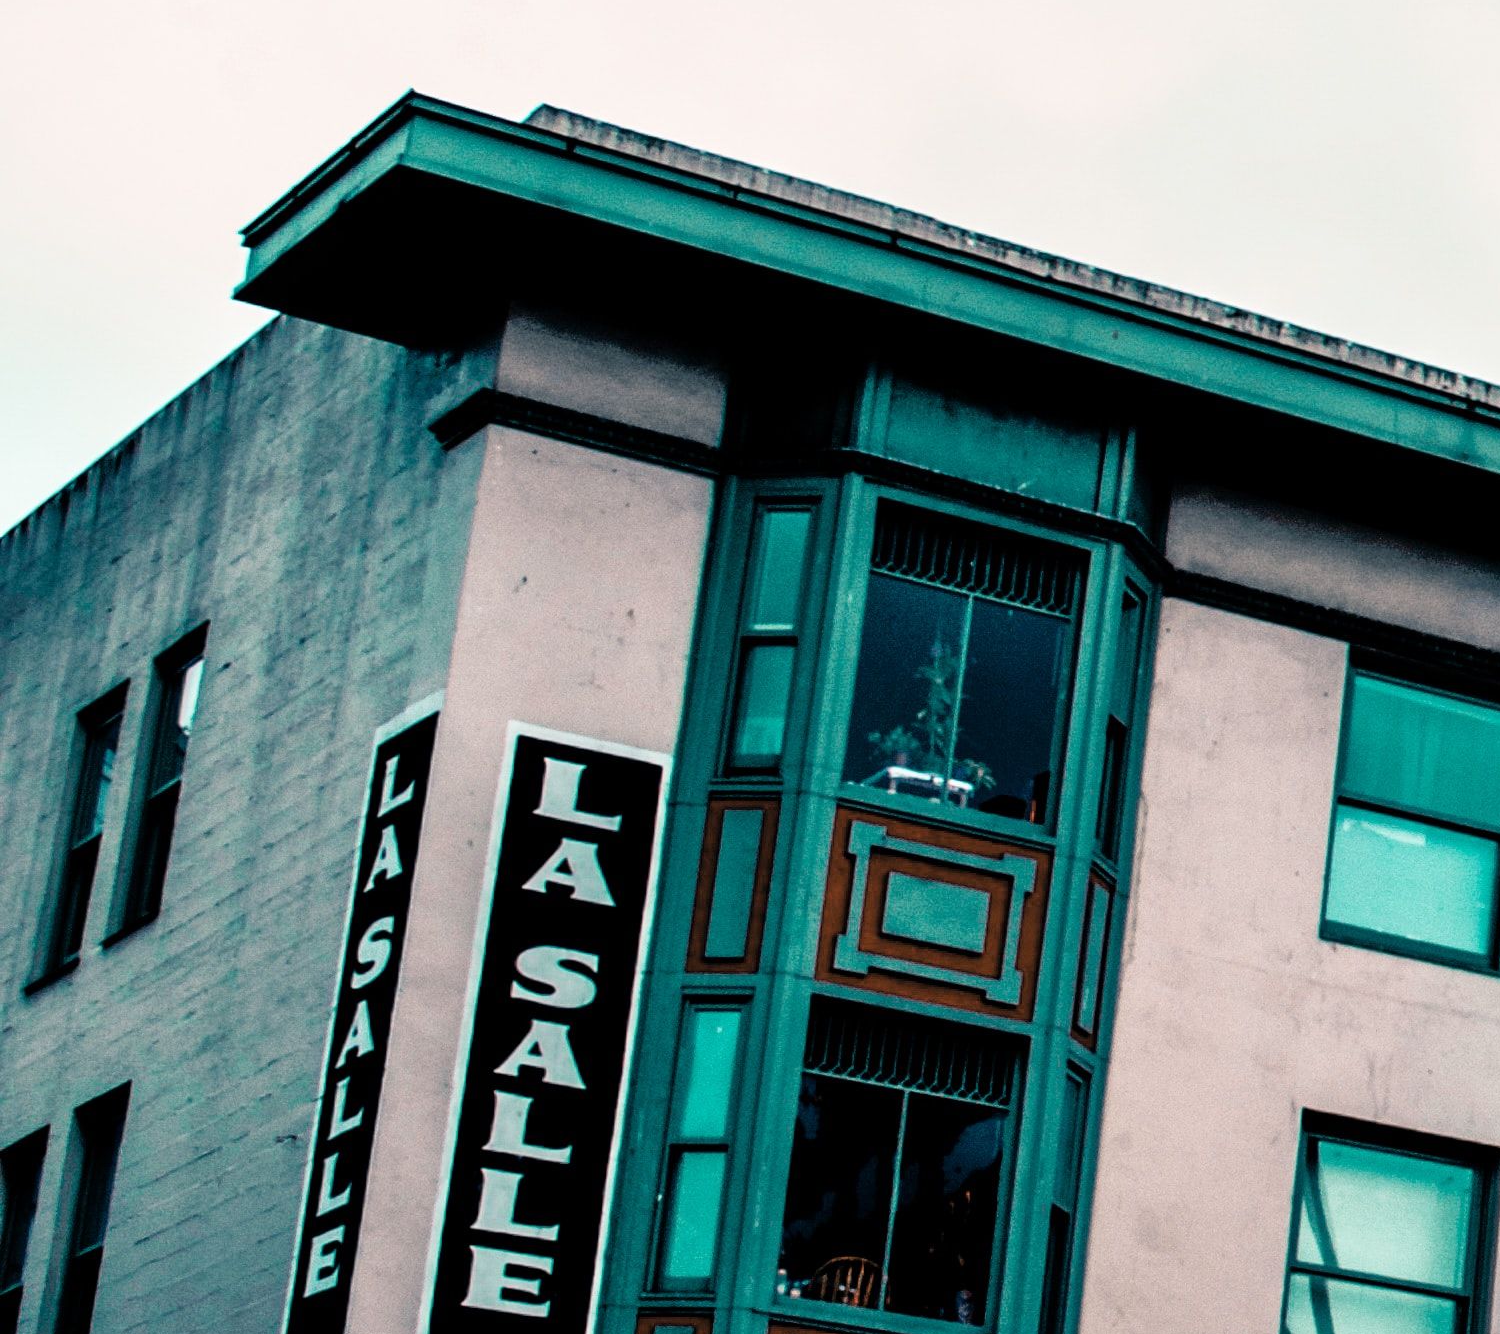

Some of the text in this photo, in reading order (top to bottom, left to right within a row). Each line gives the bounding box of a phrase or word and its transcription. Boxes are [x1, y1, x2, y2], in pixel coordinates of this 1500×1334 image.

[364, 754, 414, 893] LA
[522, 756, 624, 908] LA
[302, 914, 394, 1301] SALLE
[459, 944, 600, 1319] SALLE
